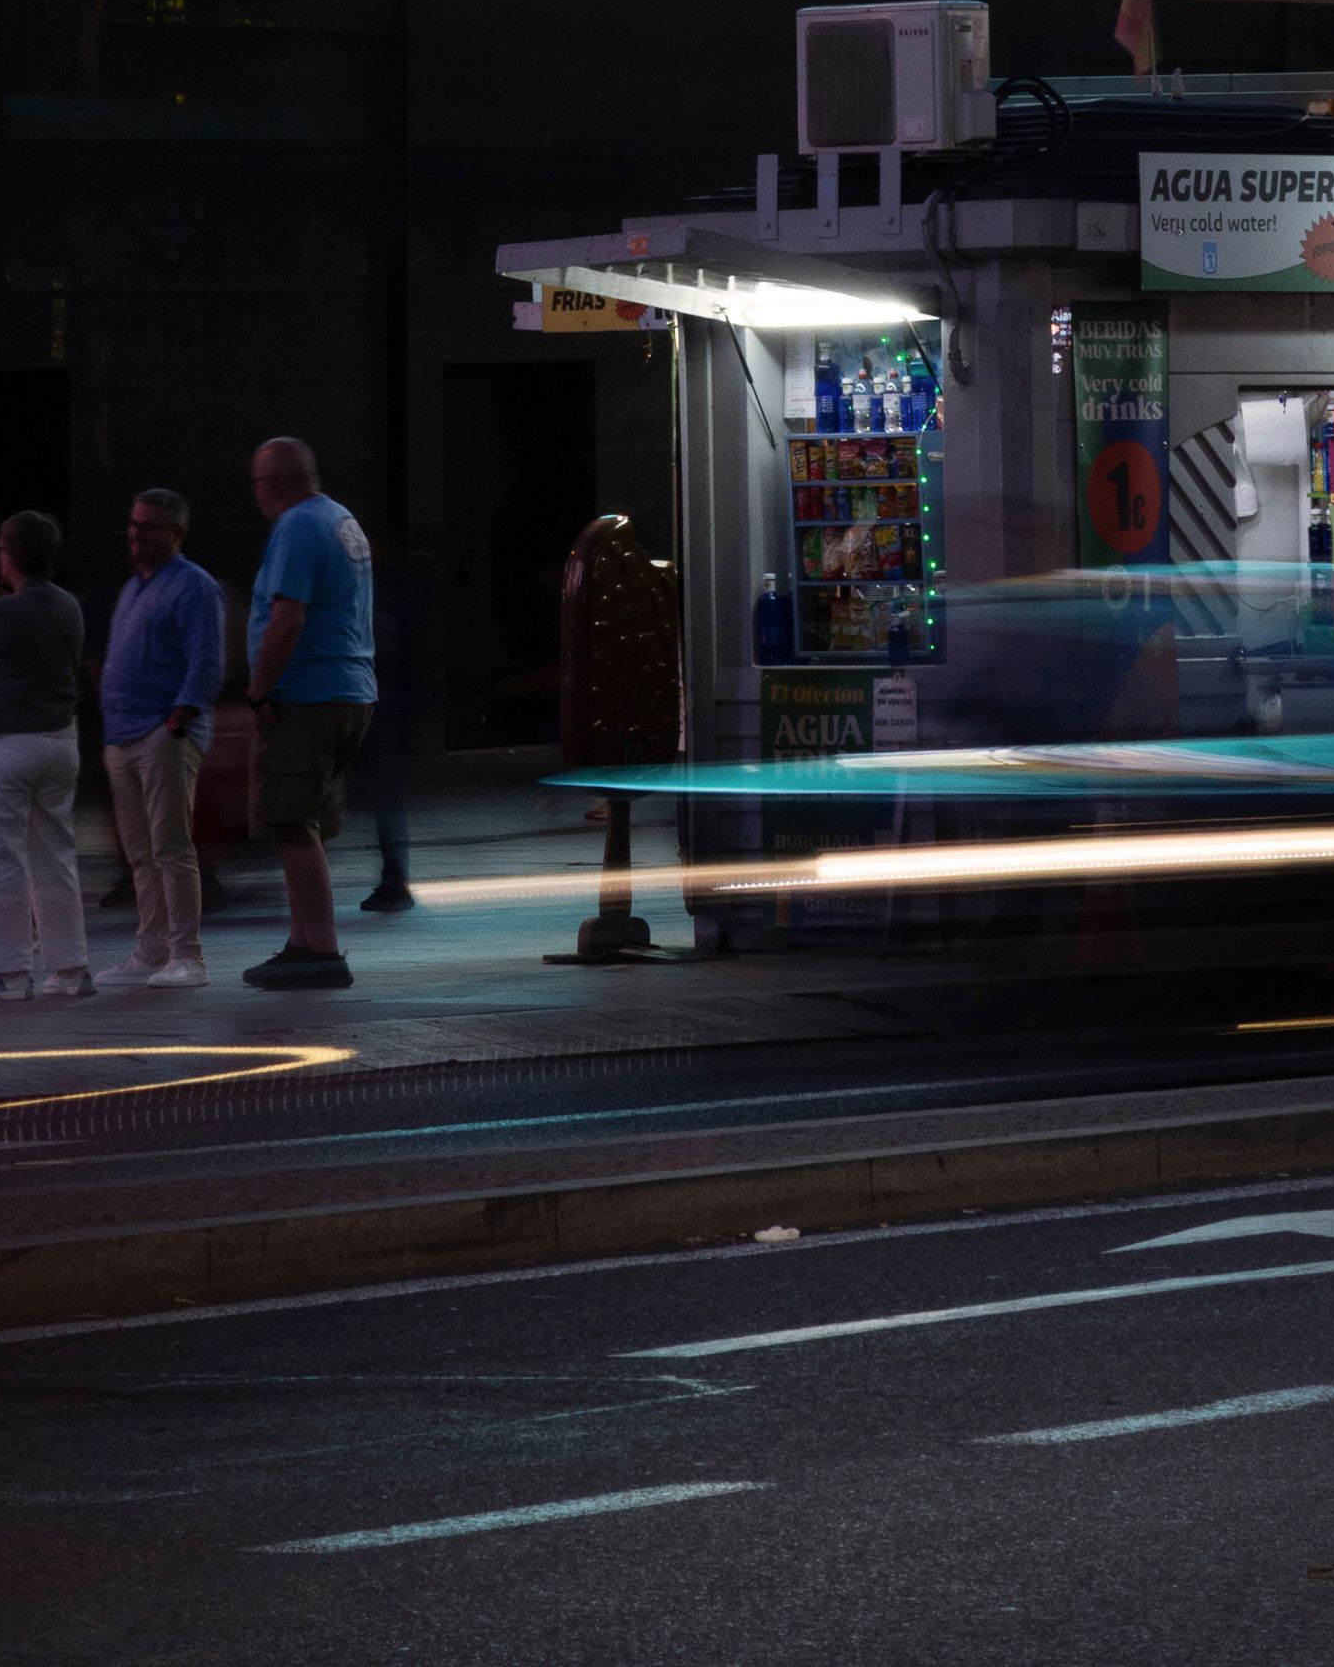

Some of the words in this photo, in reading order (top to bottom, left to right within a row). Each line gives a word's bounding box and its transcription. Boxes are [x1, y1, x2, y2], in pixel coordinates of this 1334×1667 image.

[1150, 169, 1232, 203] AGUA
[1239, 169, 1334, 204] SUPER
[1151, 213, 1187, 233] Very
[1190, 212, 1222, 233] cold
[1229, 214, 1278, 233] water!
[1079, 319, 1163, 340] BEBIDAS
[1079, 343, 1113, 359] MUY
[1080, 375, 1122, 394] Very
[1128, 372, 1163, 393] cold
[1081, 394, 1164, 421] drinks
[770, 683, 789, 704] El
[772, 714, 867, 748] AGUA
